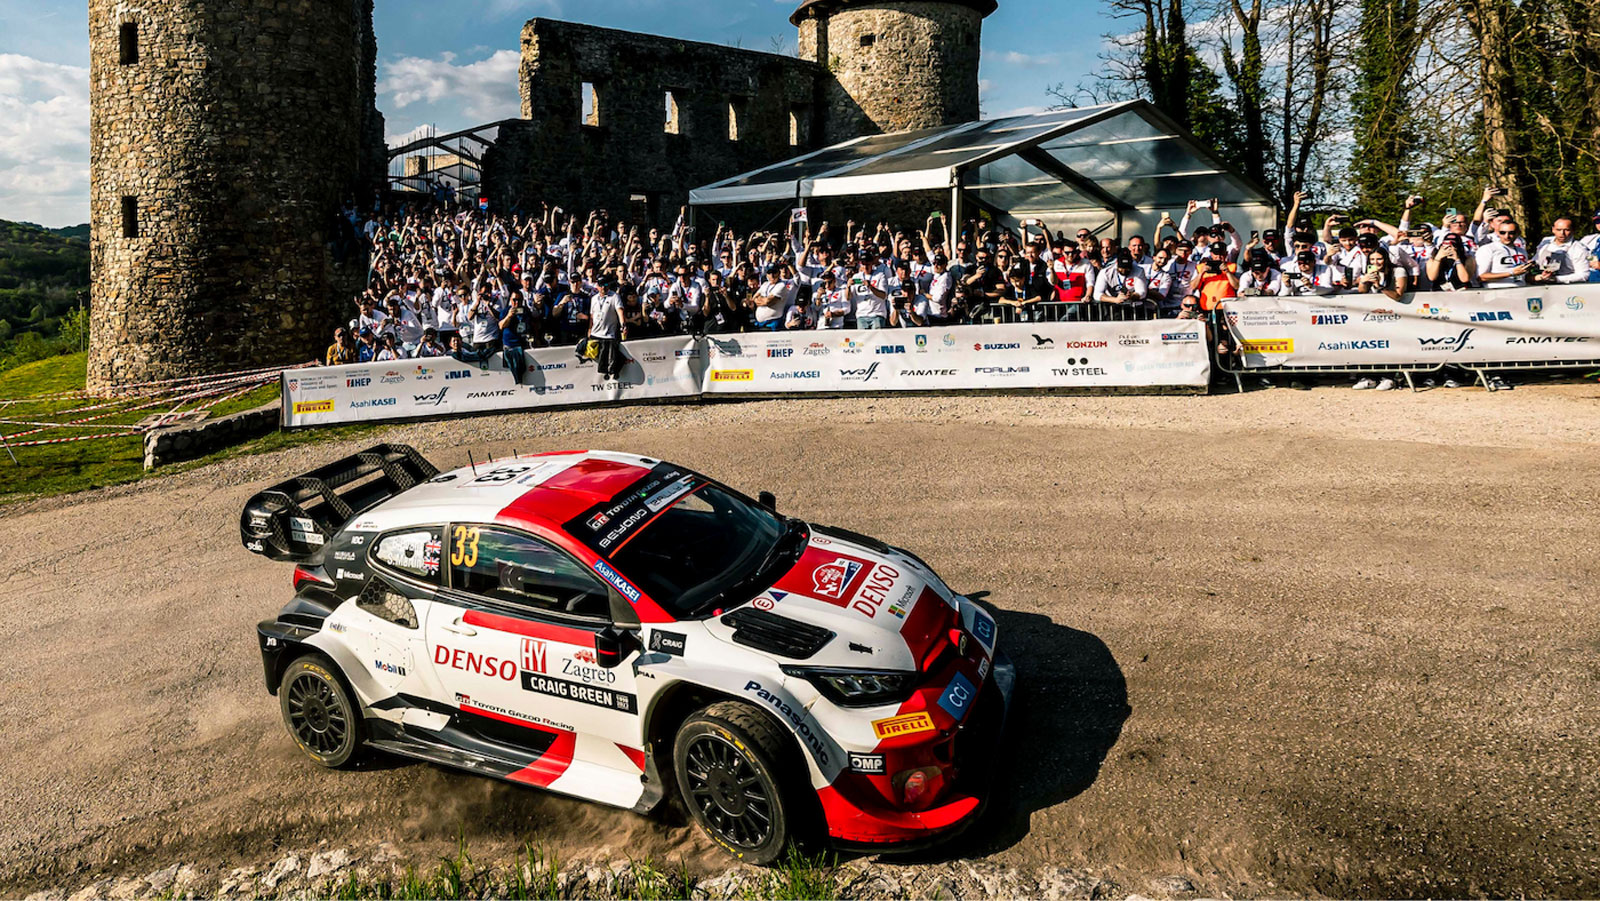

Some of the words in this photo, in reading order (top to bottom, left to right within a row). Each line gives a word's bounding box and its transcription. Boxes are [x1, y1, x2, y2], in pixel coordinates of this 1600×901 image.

[1501, 255, 1527, 264] GR
[1362, 312, 1402, 323] Zagreb
[1066, 341, 1108, 349] KONZUM
[1318, 340, 1389, 351] AsahiKASEI
[1506, 336, 1590, 344] FANATEC
[803, 347, 830, 357] Zagreb
[537, 363, 566, 371] SUZUKI
[1051, 368, 1069, 376] TW
[1072, 367, 1108, 376] STEEL
[380, 374, 405, 384] Zagreb
[770, 371, 821, 380] AsahiKASEI
[591, 384, 603, 392] TW
[606, 382, 634, 391] STEEL
[467, 390, 516, 399] FANATEC
[350, 397, 396, 409] AsahiKASEI
[591, 517, 608, 529] GR
[599, 508, 648, 548] BEYOND
[451, 525, 480, 567] 33
[595, 561, 640, 601] AsahiKASEI
[852, 564, 900, 619] DENSO
[895, 585, 915, 609] Microsoft
[662, 638, 683, 649] CRAIG
[522, 638, 547, 674] HY
[375, 660, 397, 674] Mobil
[434, 644, 517, 682] DENSO
[562, 657, 616, 684] Zagreb
[637, 670, 655, 679] PIAA
[530, 676, 568, 697] CRAIG
[570, 684, 613, 707] BREEN
[472, 699, 506, 714] TOYOTA
[508, 709, 541, 723] GAZOO
[542, 718, 575, 731] Racing
[743, 680, 829, 767] Panasonic
[876, 715, 929, 735] PIRELLI
[851, 757, 883, 770] OMP
